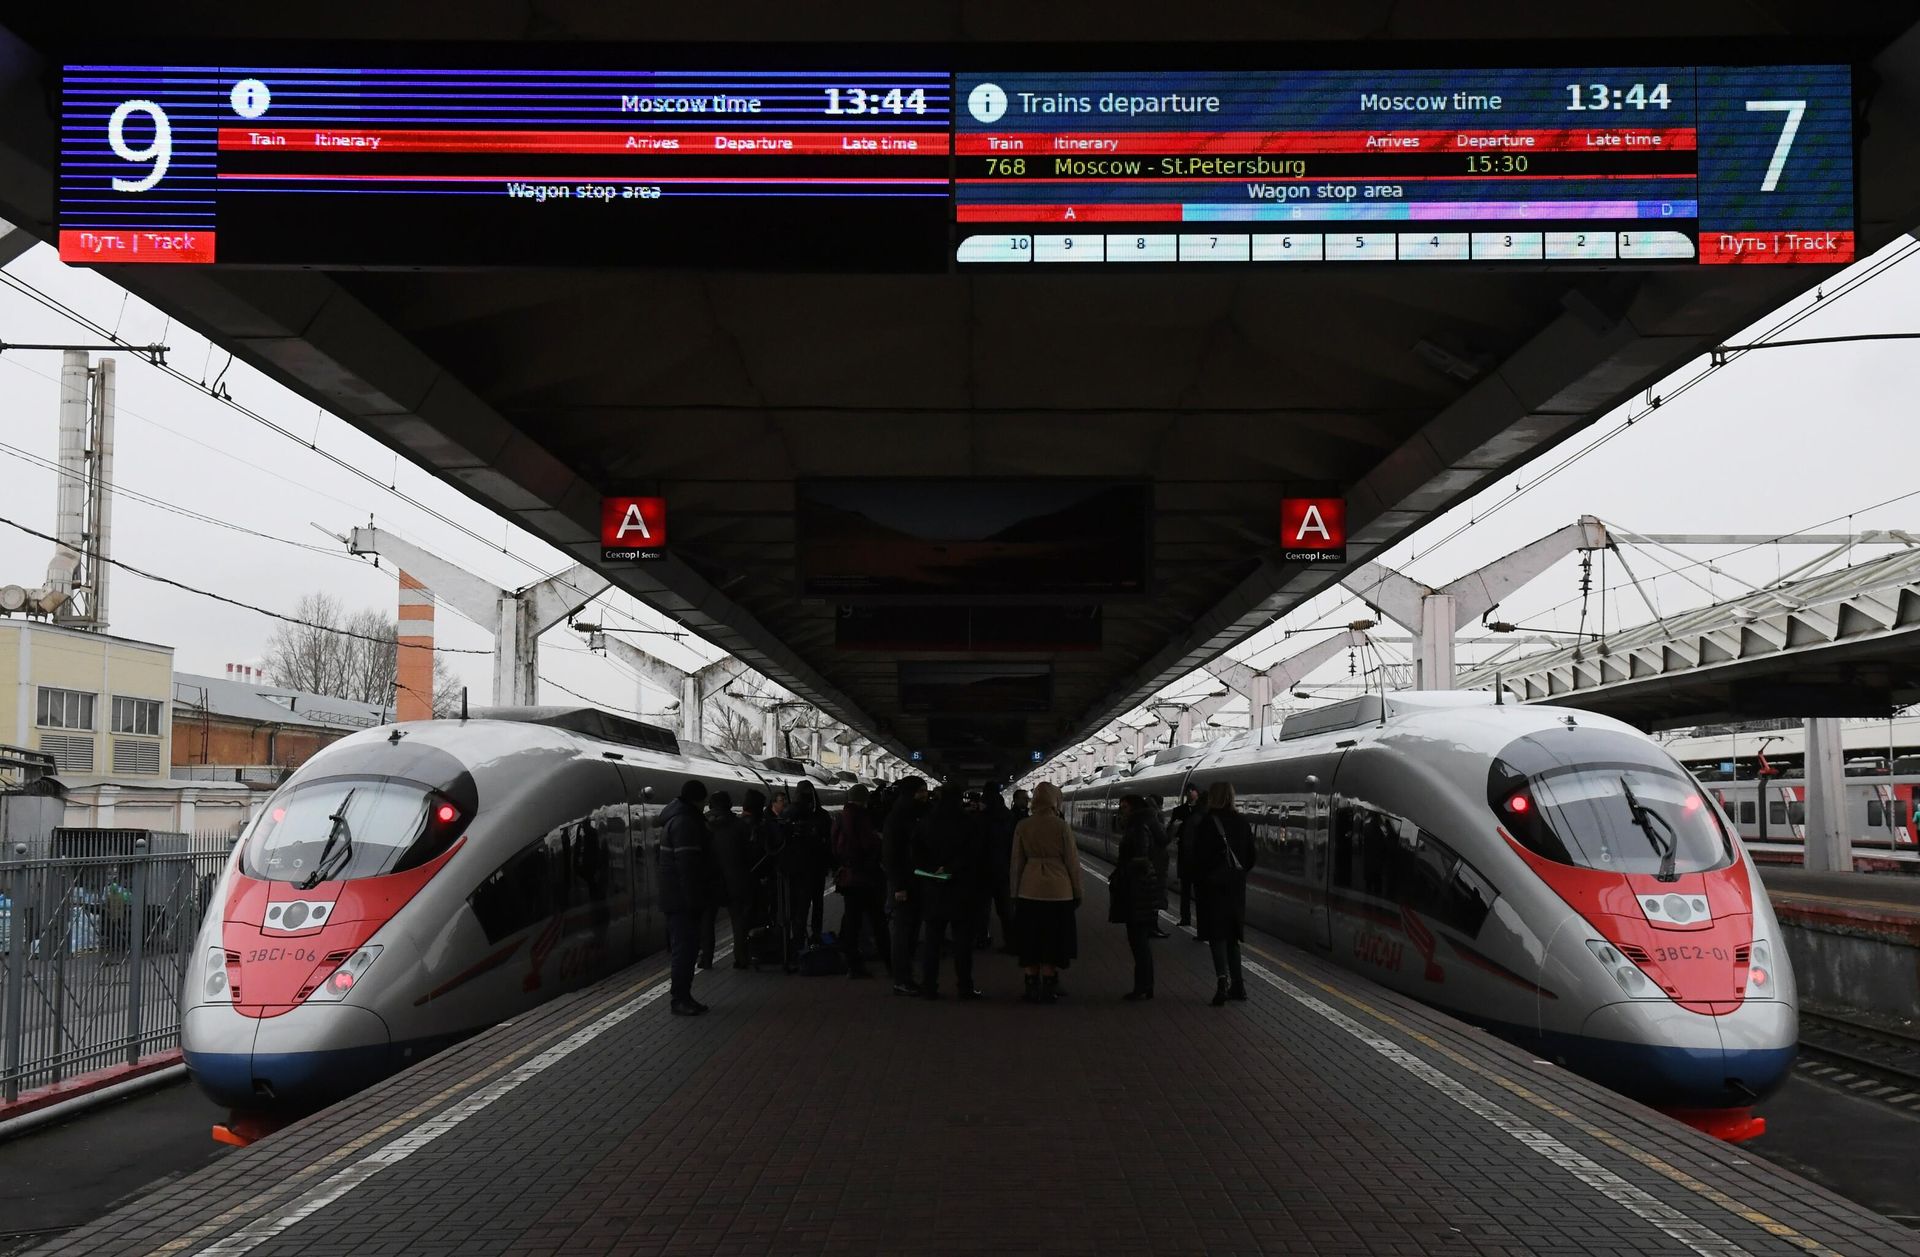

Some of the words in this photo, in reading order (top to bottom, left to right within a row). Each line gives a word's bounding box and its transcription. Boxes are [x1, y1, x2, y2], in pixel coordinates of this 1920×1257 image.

[621, 95, 707, 113] Moscow
[712, 94, 761, 113] time
[824, 88, 926, 115] 13:44
[1018, 93, 1092, 113] Trains
[1099, 92, 1220, 116] departure
[1360, 94, 1447, 112] Moscow
[1453, 92, 1502, 111] time
[1565, 84, 1671, 111] 13:44
[108, 100, 172, 192] 9
[249, 133, 286, 146] Train
[315, 133, 381, 149] Itinerary
[626, 136, 679, 149] Arrives
[715, 136, 793, 151] Departure
[842, 136, 877, 150] Late
[881, 136, 918, 150] time
[987, 137, 1024, 150] Train
[1054, 136, 1118, 152] Itinerary
[1366, 135, 1420, 148] Arrives
[1457, 134, 1535, 149] Departure
[1586, 133, 1621, 146] Late
[1625, 132, 1661, 146] time
[1745, 101, 1806, 192] 7
[985, 158, 1027, 176] 768
[1054, 158, 1140, 175] Moscow
[1160, 157, 1306, 178] St.Petersburg
[1466, 155, 1529, 173] 15:30
[507, 183, 570, 202] Wagon
[576, 182, 616, 201] stop
[622, 185, 661, 199] area
[1247, 183, 1310, 202] Wagon
[1316, 182, 1358, 201] stop
[1363, 185, 1403, 198] area
[1064, 207, 1076, 219] A
[1661, 204, 1674, 216] D
[80, 233, 127, 252] Путь
[144, 233, 195, 250] Track
[1011, 239, 1028, 249] 10
[1064, 238, 1073, 249] 9
[1137, 238, 1145, 249] 8
[1209, 238, 1218, 248] 7
[1282, 237, 1292, 249] 6
[1356, 237, 1365, 248] 5
[1430, 236, 1440, 247] 4
[1503, 236, 1513, 248] 3
[1577, 236, 1586, 247] 2
[1623, 235, 1631, 247] 1
[1720, 235, 1766, 252] Путь
[1786, 234, 1837, 250] Track
[605, 551, 636, 560] Сектор
[1285, 552, 1316, 561] Сектор
